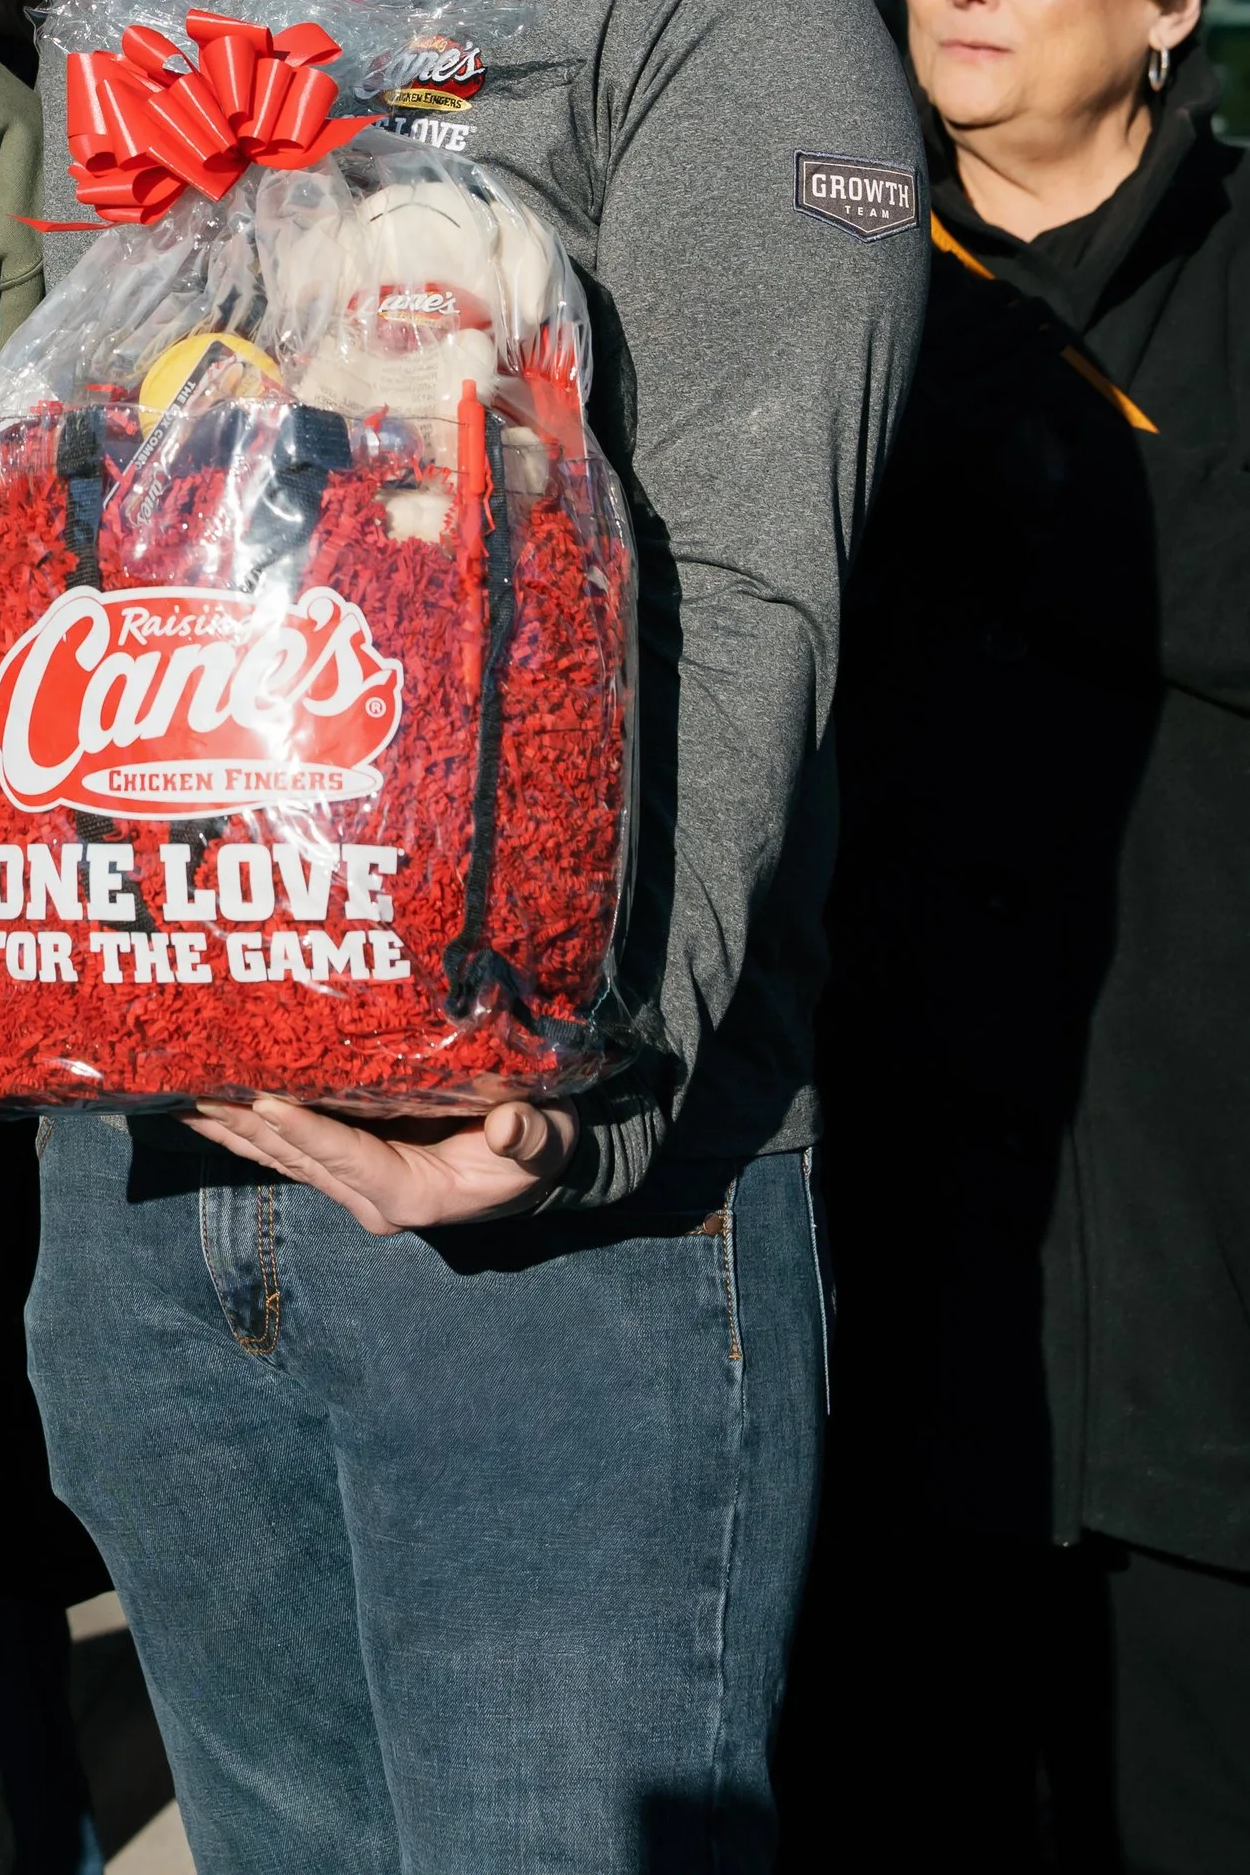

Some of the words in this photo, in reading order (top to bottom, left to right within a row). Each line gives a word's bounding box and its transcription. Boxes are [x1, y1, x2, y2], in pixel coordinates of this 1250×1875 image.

[812, 173, 910, 209] GROWTH
[845, 205, 889, 219] TEAM
[118, 606, 252, 646] Raising
[2, 596, 396, 796] Cane's
[108, 770, 215, 792] CHICKEN
[225, 770, 344, 792] FINGERS
[160, 844, 398, 921] LOVE
[90, 931, 213, 983] THE
[227, 930, 411, 983] GAME
